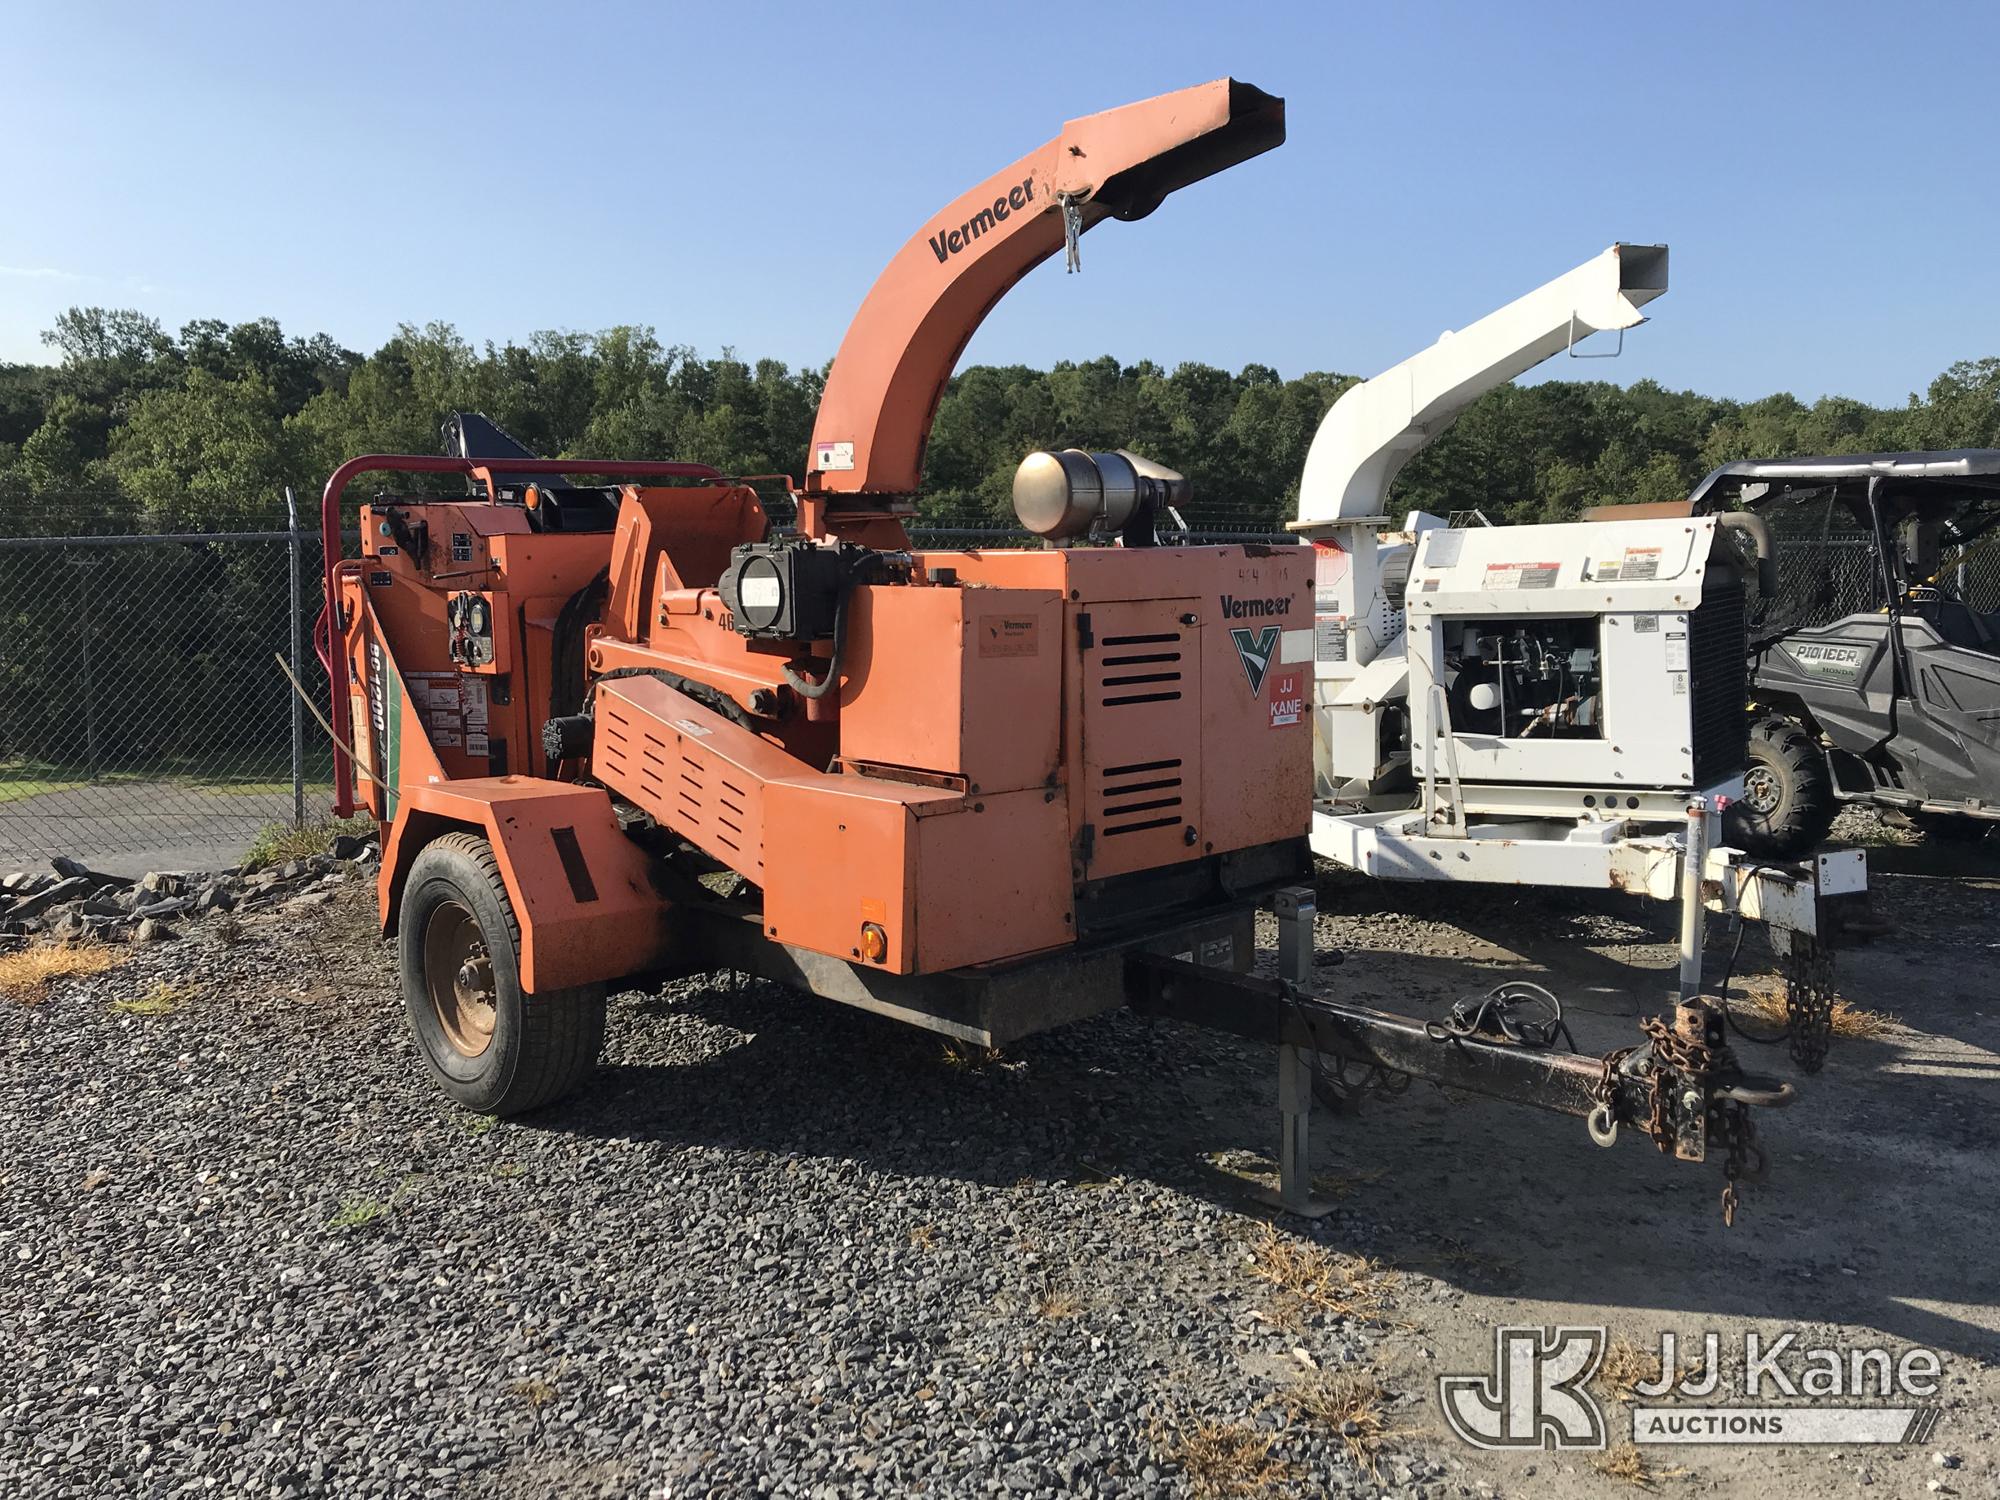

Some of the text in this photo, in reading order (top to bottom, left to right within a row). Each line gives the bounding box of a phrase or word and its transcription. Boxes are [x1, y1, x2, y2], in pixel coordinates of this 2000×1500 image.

[928, 176, 1034, 264] Vermeer
[1316, 548, 1341, 559] TOP!
[1219, 594, 1292, 619] Vermeer
[1796, 645, 1858, 662] PIONEER
[1822, 667, 1855, 677] HONDA
[1279, 678, 1293, 694] JJ
[1270, 698, 1302, 717] KANE
